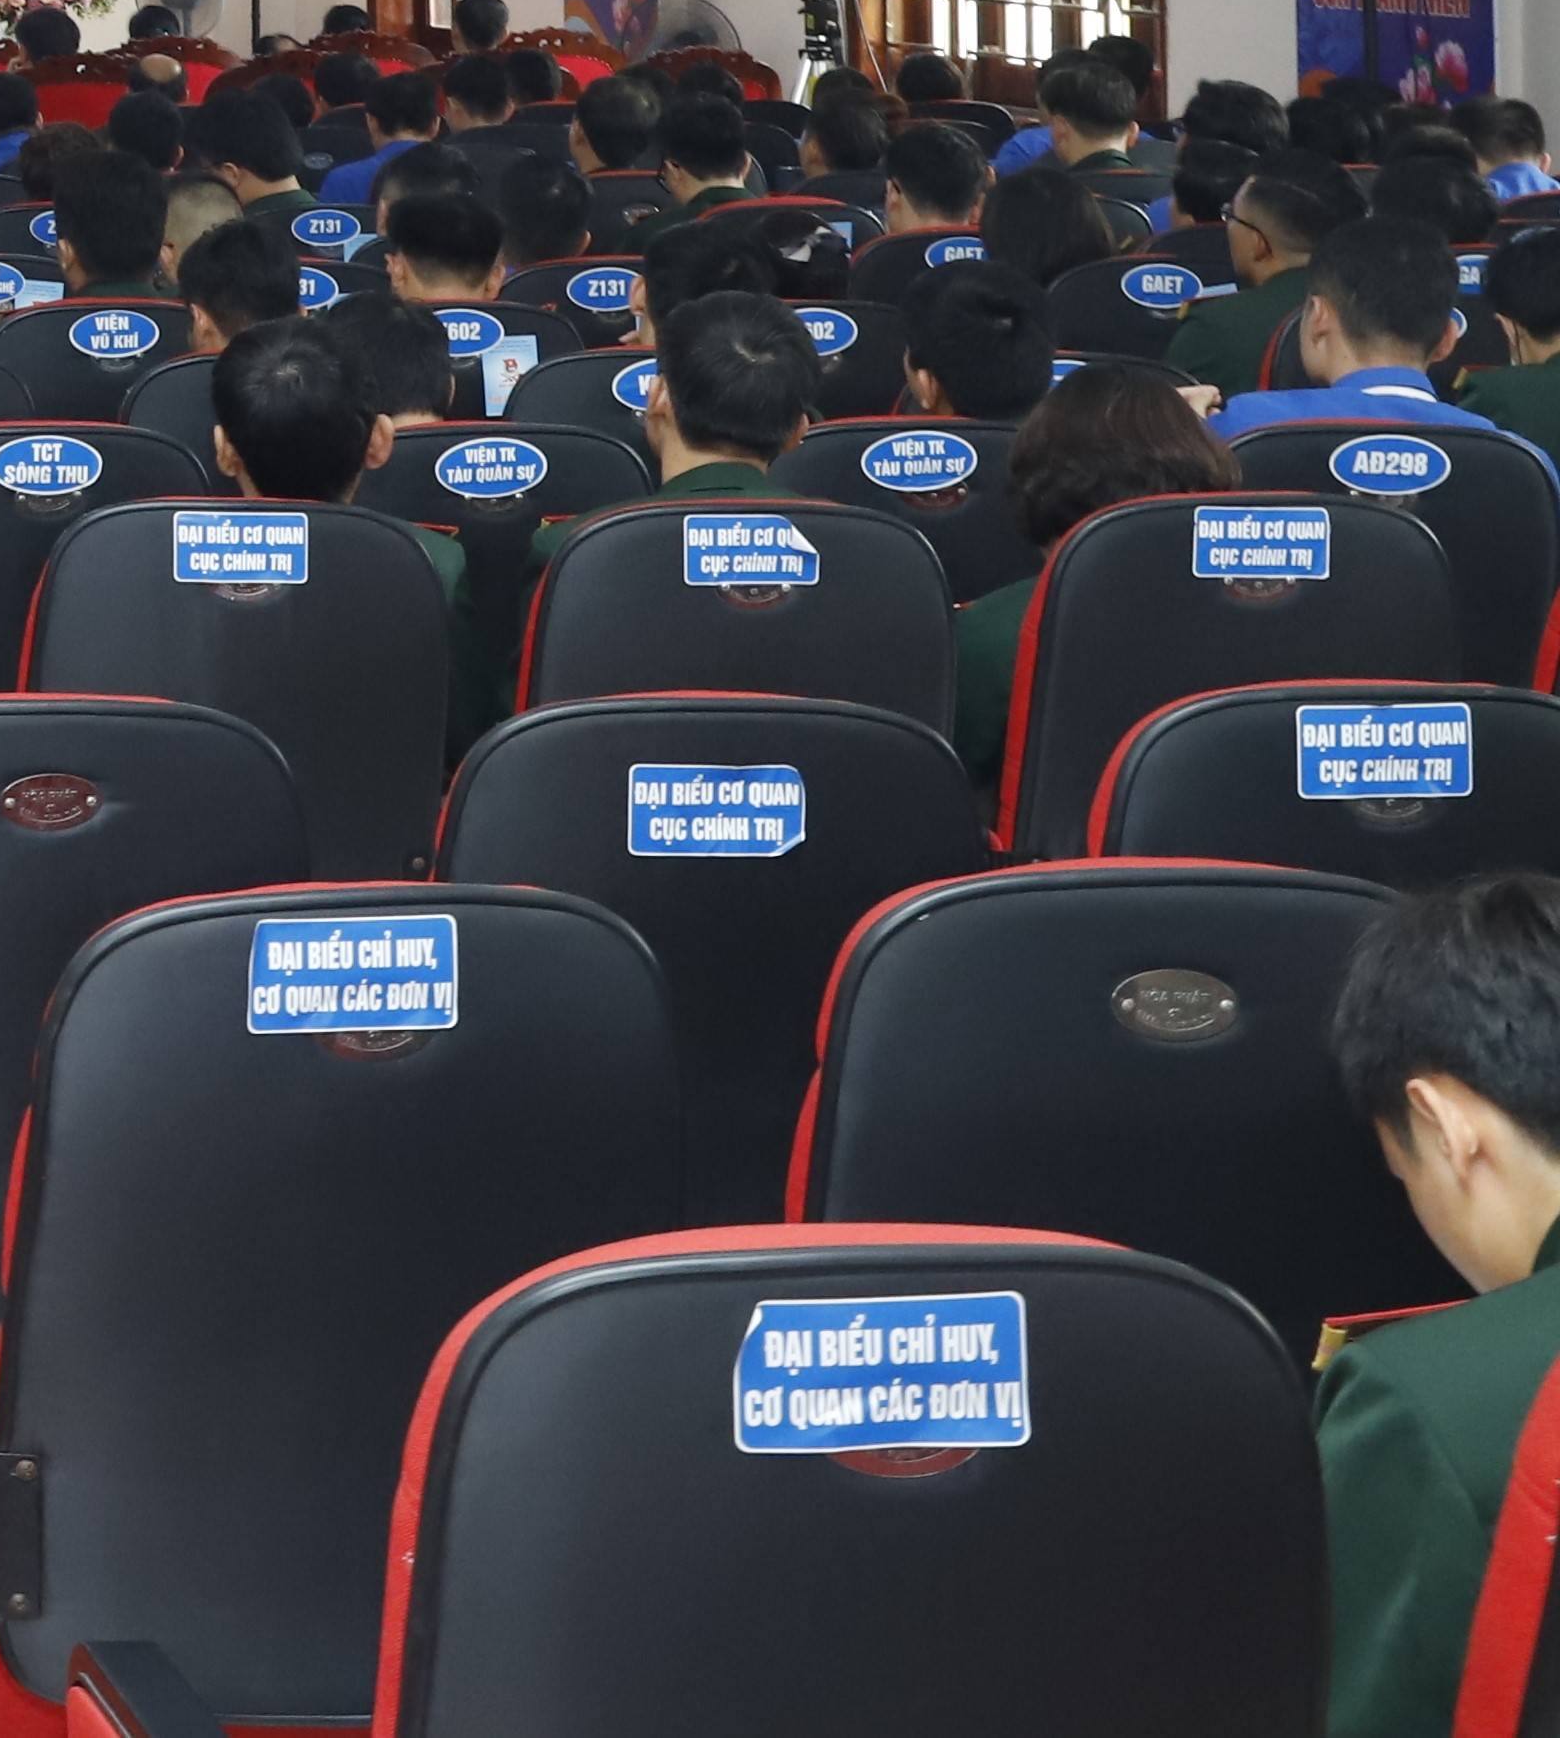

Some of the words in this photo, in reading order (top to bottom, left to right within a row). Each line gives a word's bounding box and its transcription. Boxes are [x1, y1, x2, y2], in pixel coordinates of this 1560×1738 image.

[309, 219, 341, 235] Z131
[1142, 274, 1183, 294] GAET
[1353, 452, 1429, 477] AĐ298
[634, 782, 667, 810] ĐẠI
[672, 774, 714, 806] BIỂU
[719, 780, 745, 805] CƠ
[748, 782, 799, 808] QUAN
[649, 817, 687, 845] CỤC
[692, 813, 750, 841] CHÍNH
[754, 818, 784, 845] TRỊ
